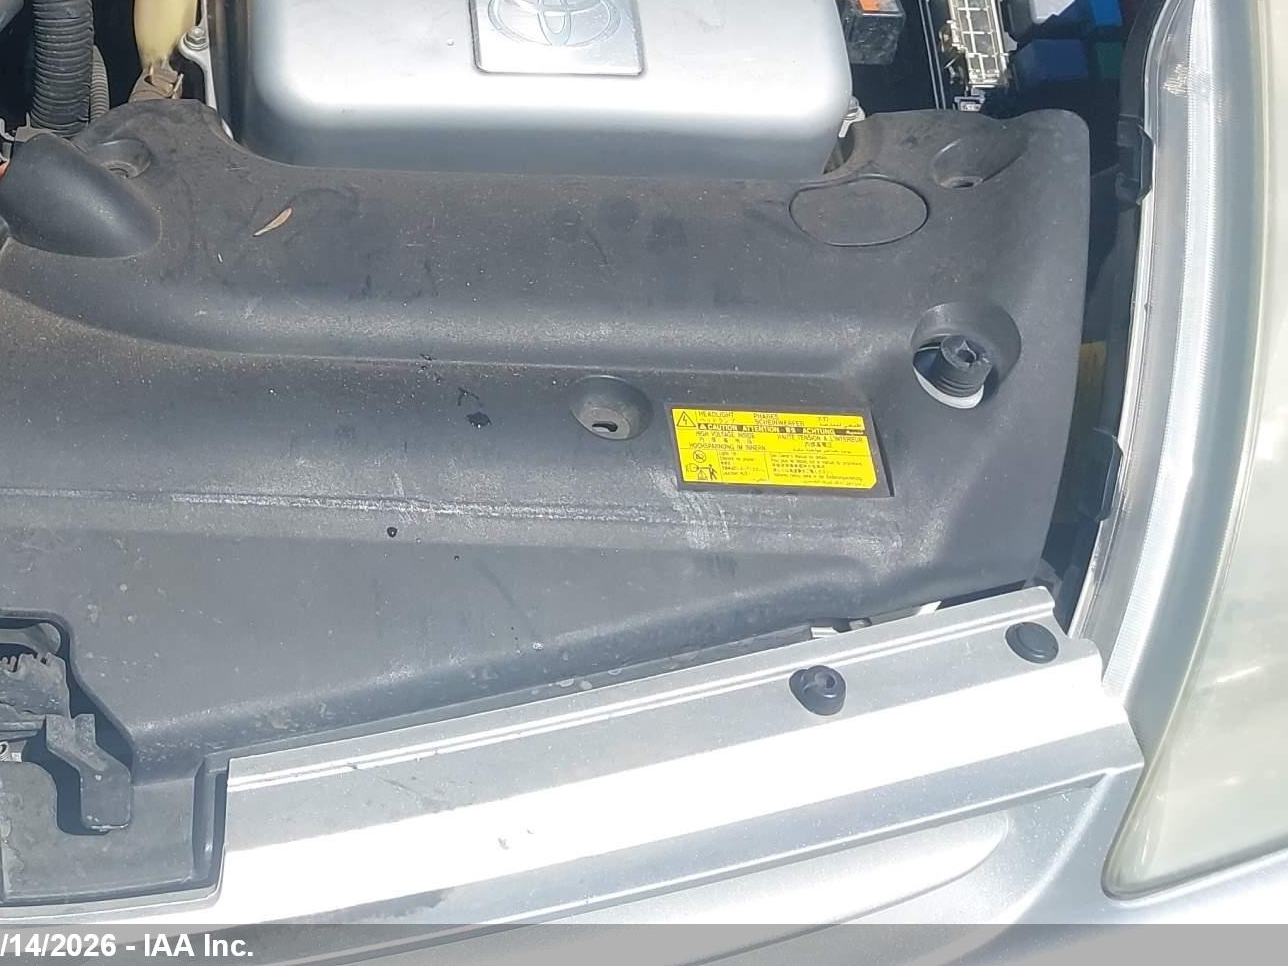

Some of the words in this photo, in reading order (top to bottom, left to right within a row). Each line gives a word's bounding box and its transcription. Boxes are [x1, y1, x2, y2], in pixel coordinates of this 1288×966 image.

[707, 423, 738, 431] CAUTION
[742, 425, 778, 433] ATTENTION
[803, 427, 835, 435] ACHTUNG
